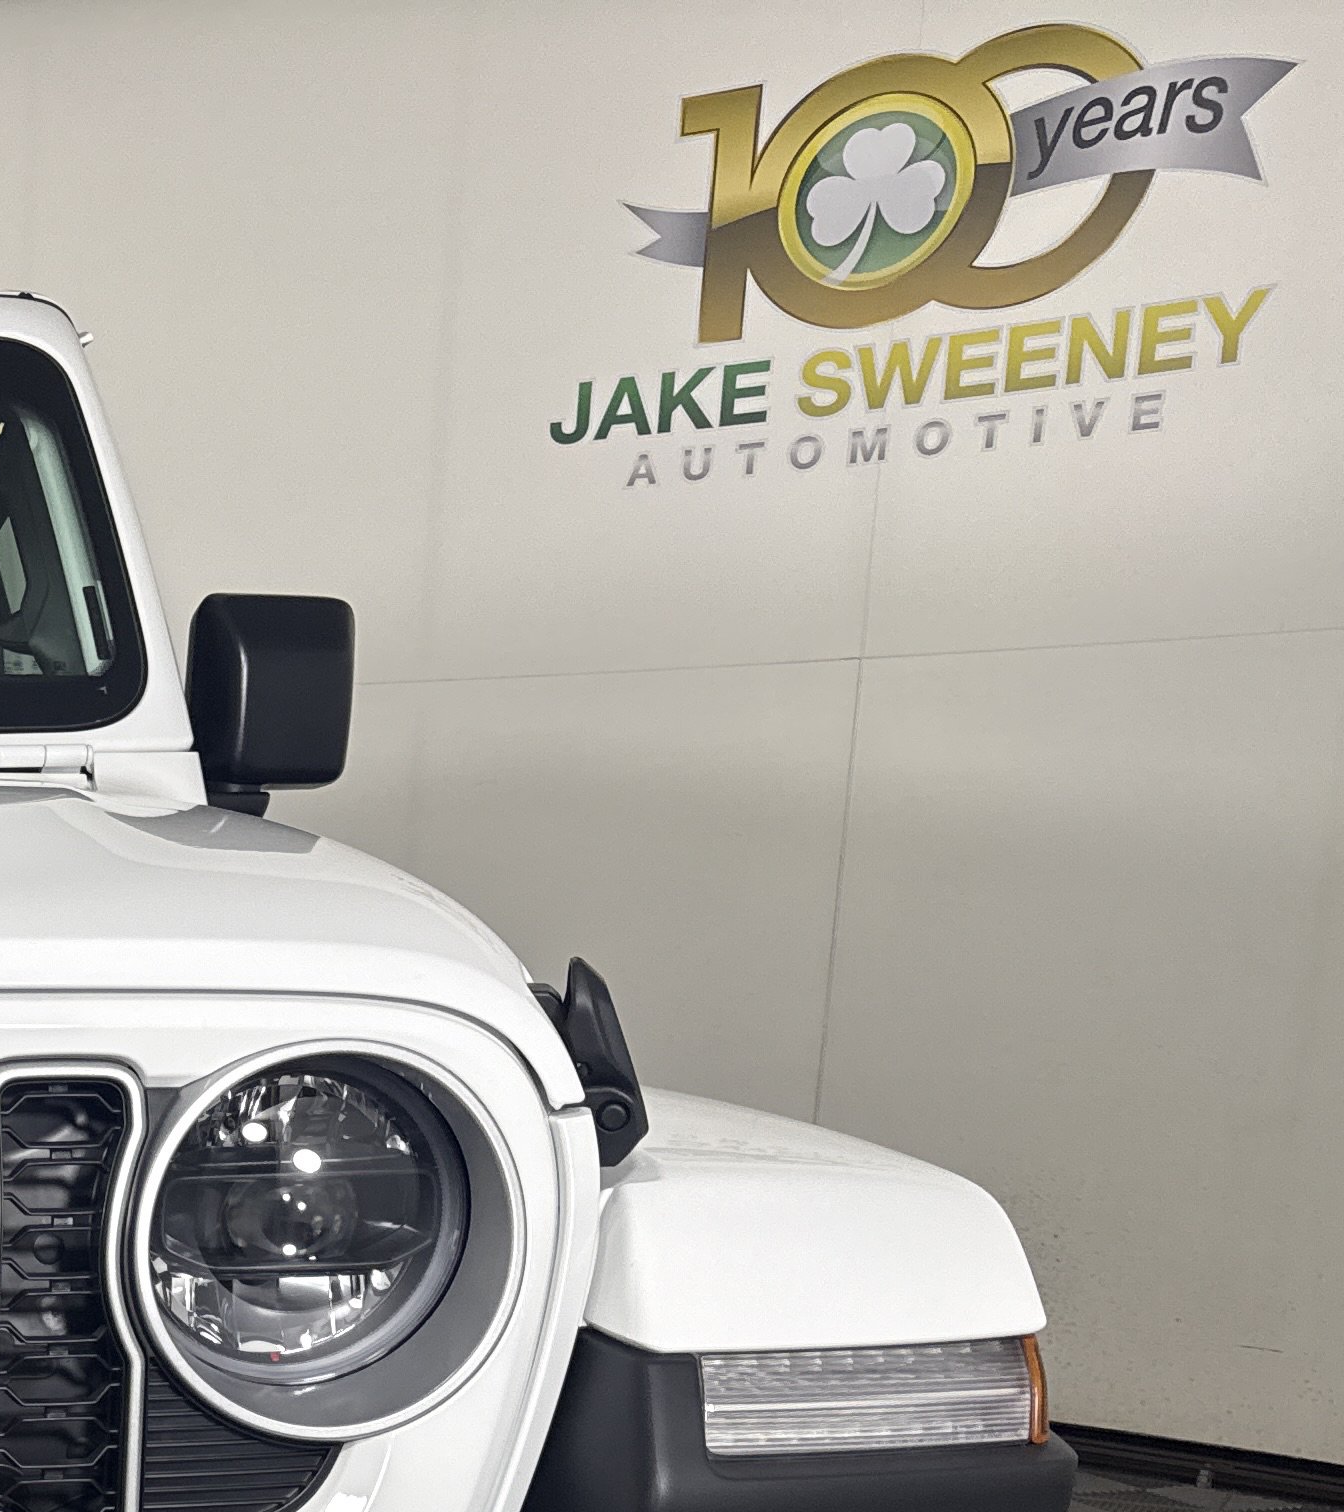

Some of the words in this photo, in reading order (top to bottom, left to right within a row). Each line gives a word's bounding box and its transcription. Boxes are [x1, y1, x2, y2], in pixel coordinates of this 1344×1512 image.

[1027, 75, 1230, 181] years
[549, 358, 773, 447] JAKE
[798, 285, 1274, 419] SWEENEY
[627, 390, 1164, 488] AUTOMOTIVE
